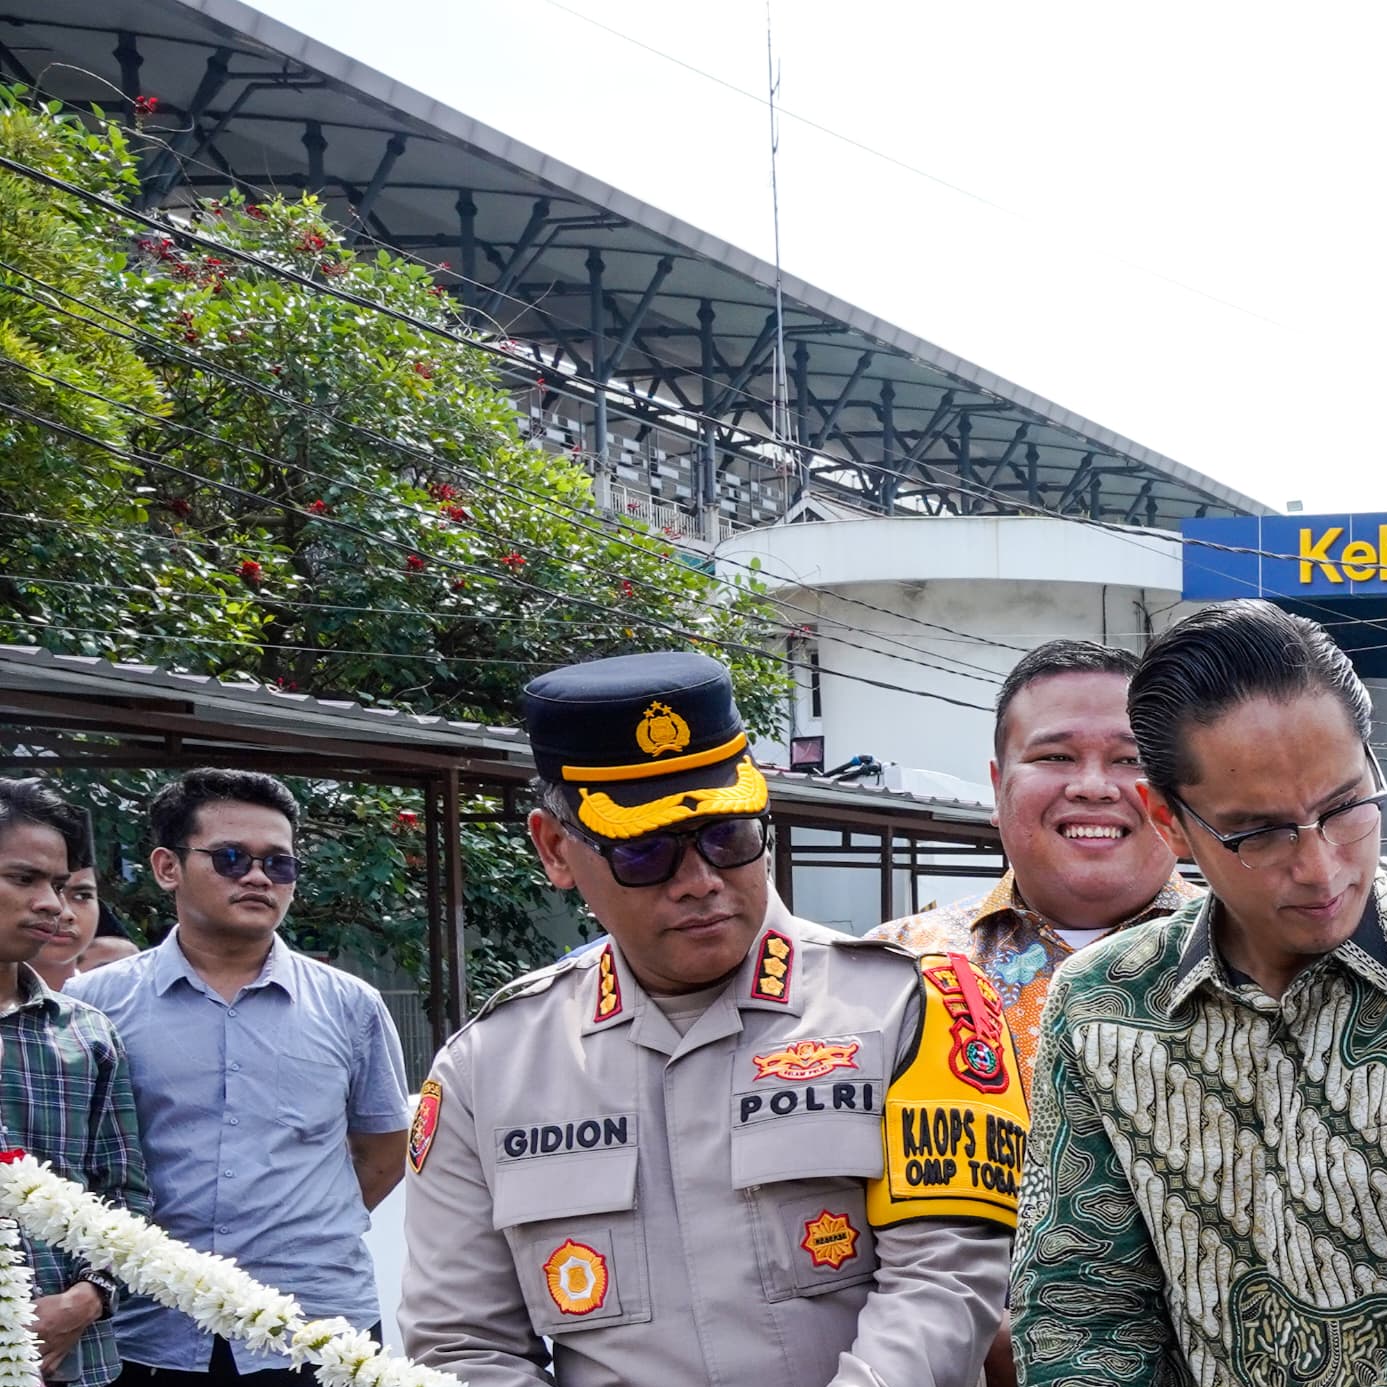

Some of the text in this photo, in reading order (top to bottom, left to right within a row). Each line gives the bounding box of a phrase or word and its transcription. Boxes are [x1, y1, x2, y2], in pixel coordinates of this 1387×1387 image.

[740, 1082, 873, 1122] POLRI
[504, 1116, 628, 1157] GIDION
[902, 1107, 976, 1159] KAOPS
[906, 1158, 956, 1186] OMP
